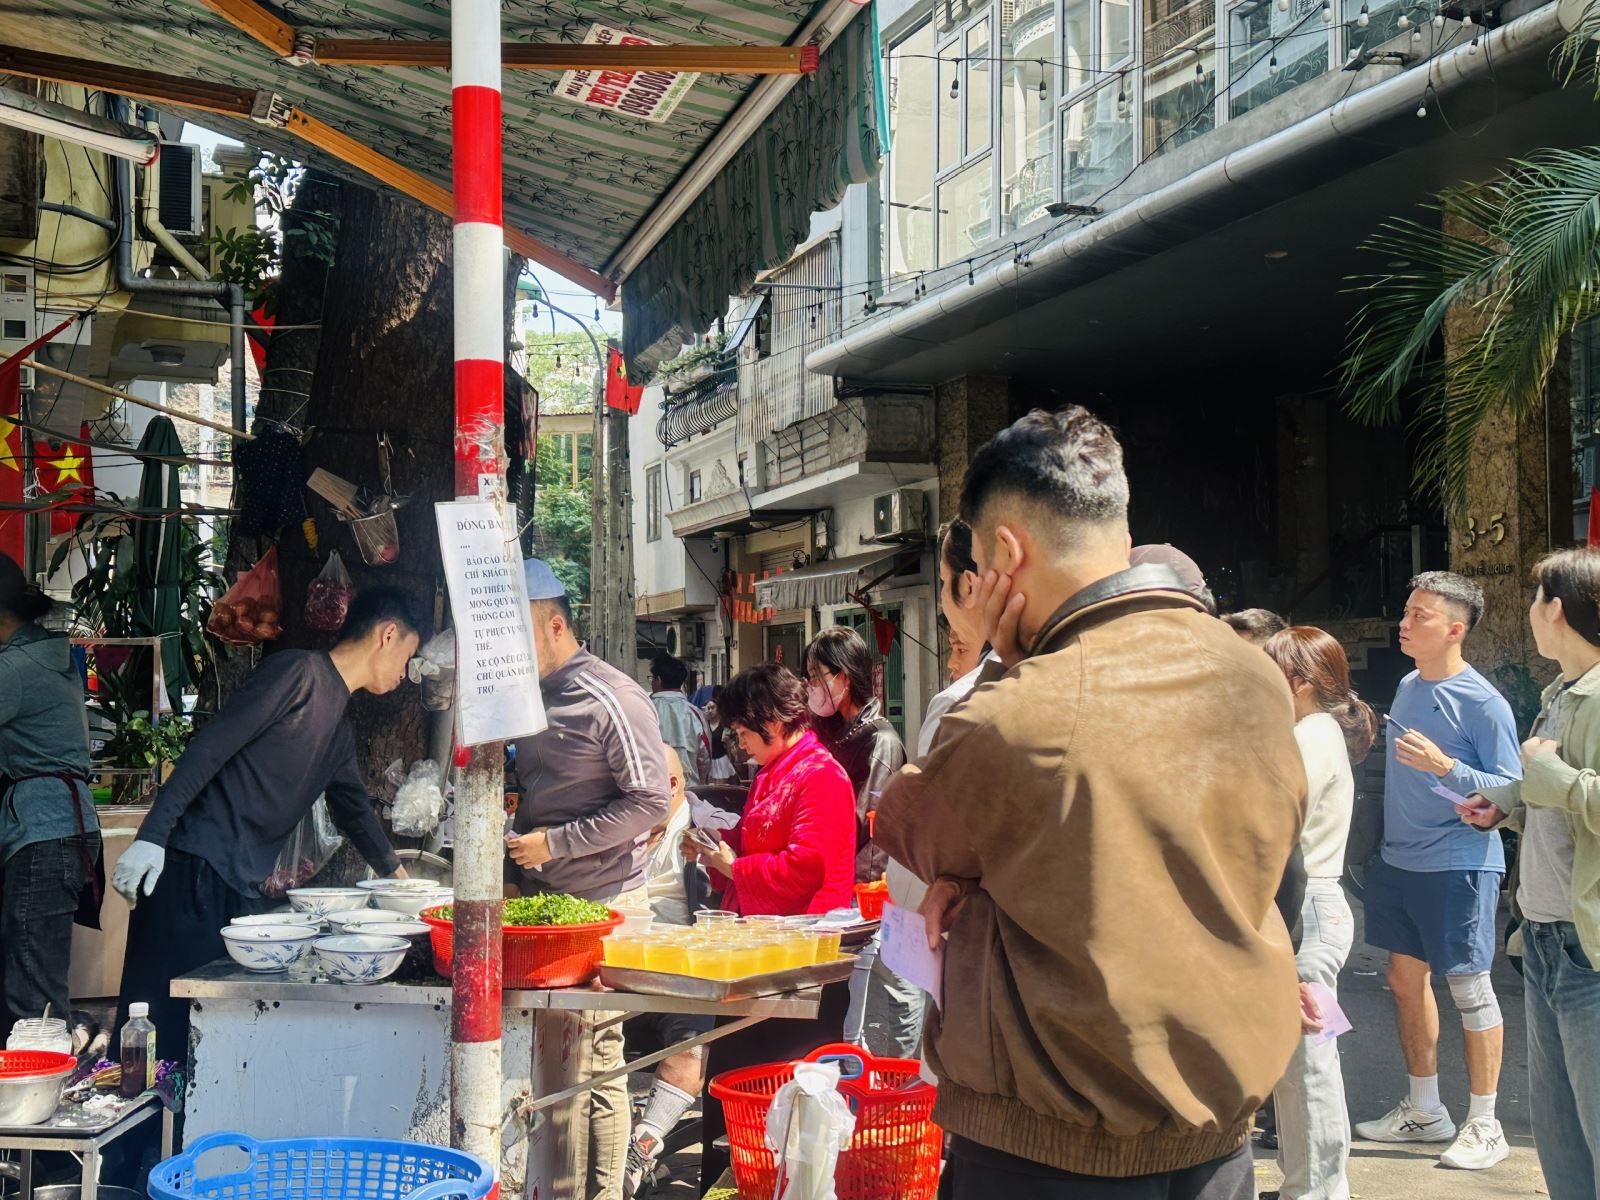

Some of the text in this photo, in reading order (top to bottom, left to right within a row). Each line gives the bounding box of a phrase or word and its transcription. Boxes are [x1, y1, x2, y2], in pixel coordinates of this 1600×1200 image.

[573, 69, 592, 86] HIÊ
[565, 82, 584, 97] MÁI
[469, 598, 493, 609] MONG
